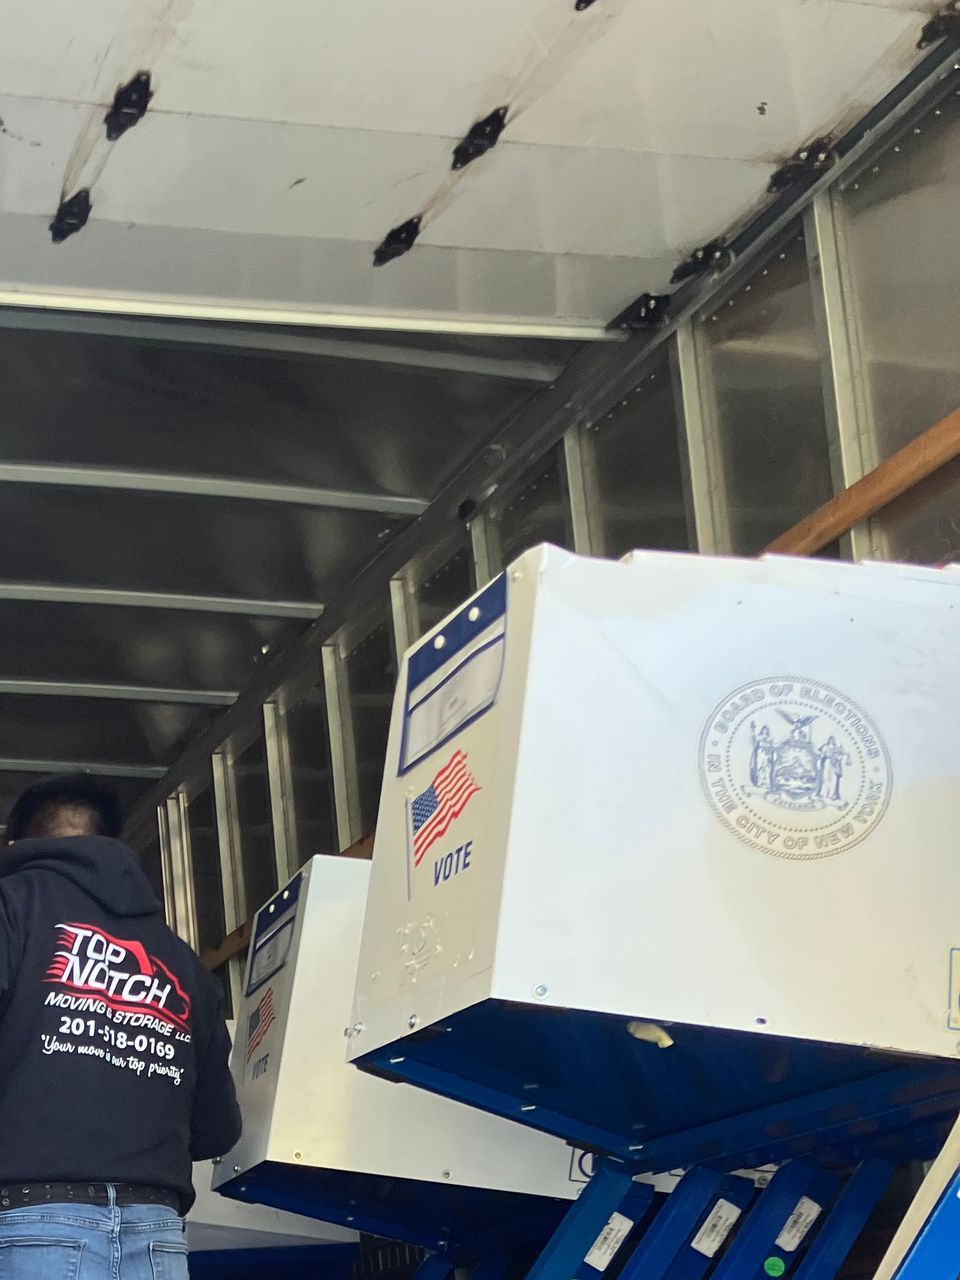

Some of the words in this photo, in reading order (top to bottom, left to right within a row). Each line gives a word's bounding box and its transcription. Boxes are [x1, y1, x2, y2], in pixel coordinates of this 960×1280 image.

[714, 688, 766, 735] BOARD
[769, 684, 794, 698] OF
[736, 815, 780, 845] CITY
[783, 836, 809, 850] OF
[814, 822, 856, 849] NEW
[433, 840, 474, 886] VOTE
[54, 923, 126, 965] TOP
[54, 951, 171, 1009] NOTCH
[44, 991, 106, 1014] MOVING
[106, 1007, 113, 1018] &
[113, 1011, 174, 1036] STORAGE
[175, 1031, 192, 1043] LLC
[127, 1056, 145, 1075] top
[252, 1053, 270, 1081] VOTE
